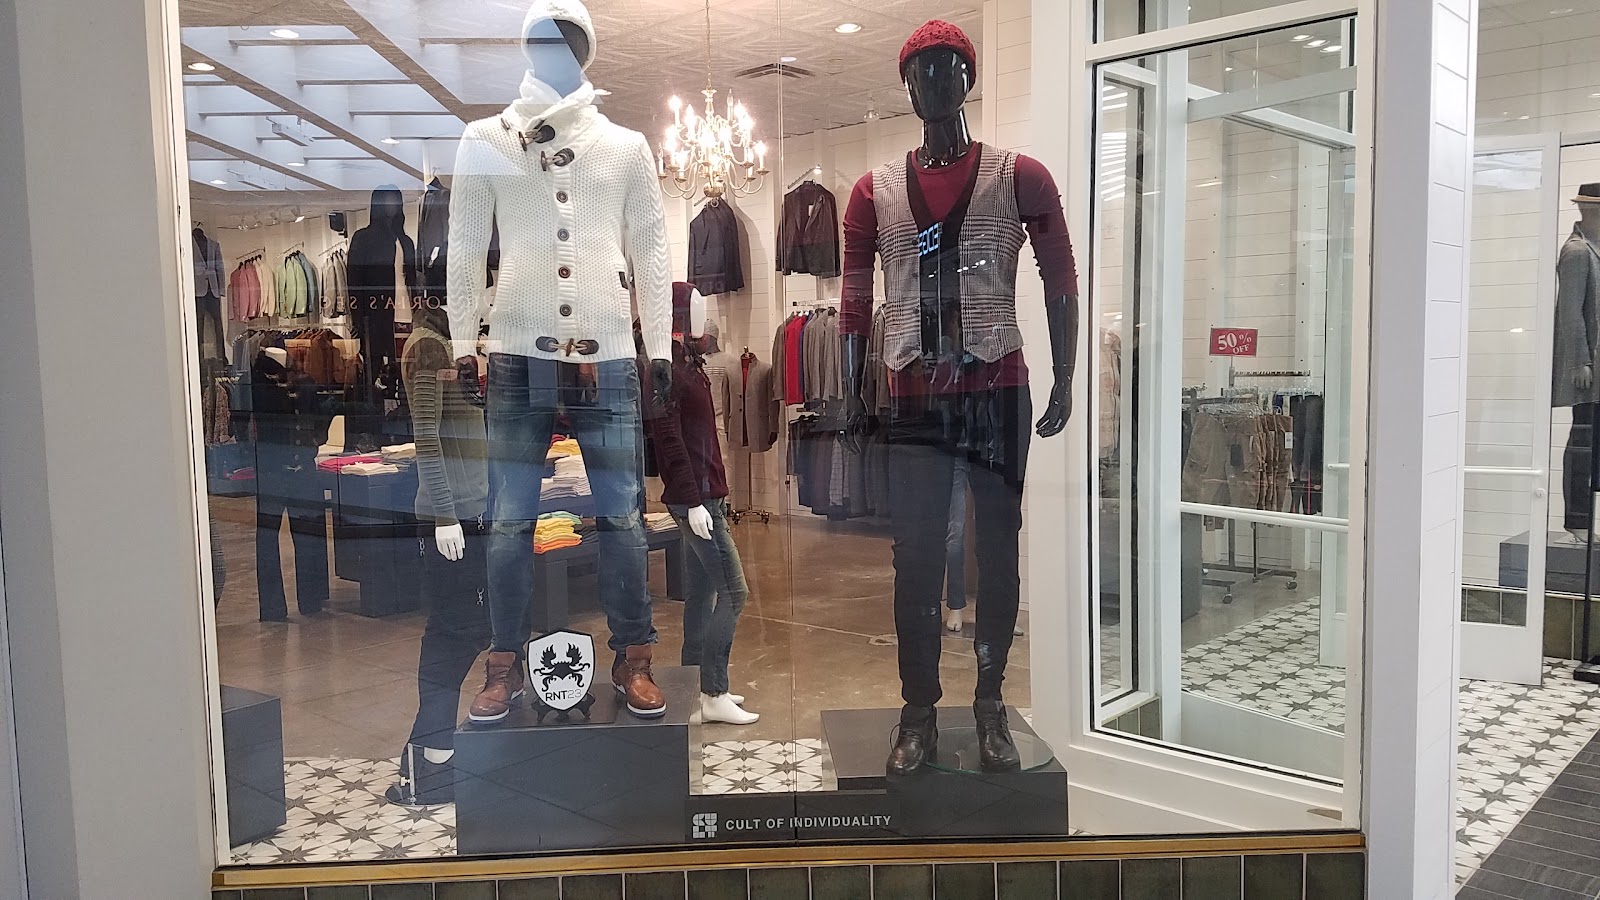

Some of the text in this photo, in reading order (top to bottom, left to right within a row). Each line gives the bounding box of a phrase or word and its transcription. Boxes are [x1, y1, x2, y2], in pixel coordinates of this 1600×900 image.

[1232, 344, 1250, 354] OFF
[545, 688, 582, 702] RNT23
[725, 815, 892, 831] CULT OF INDIVIDUALITY
